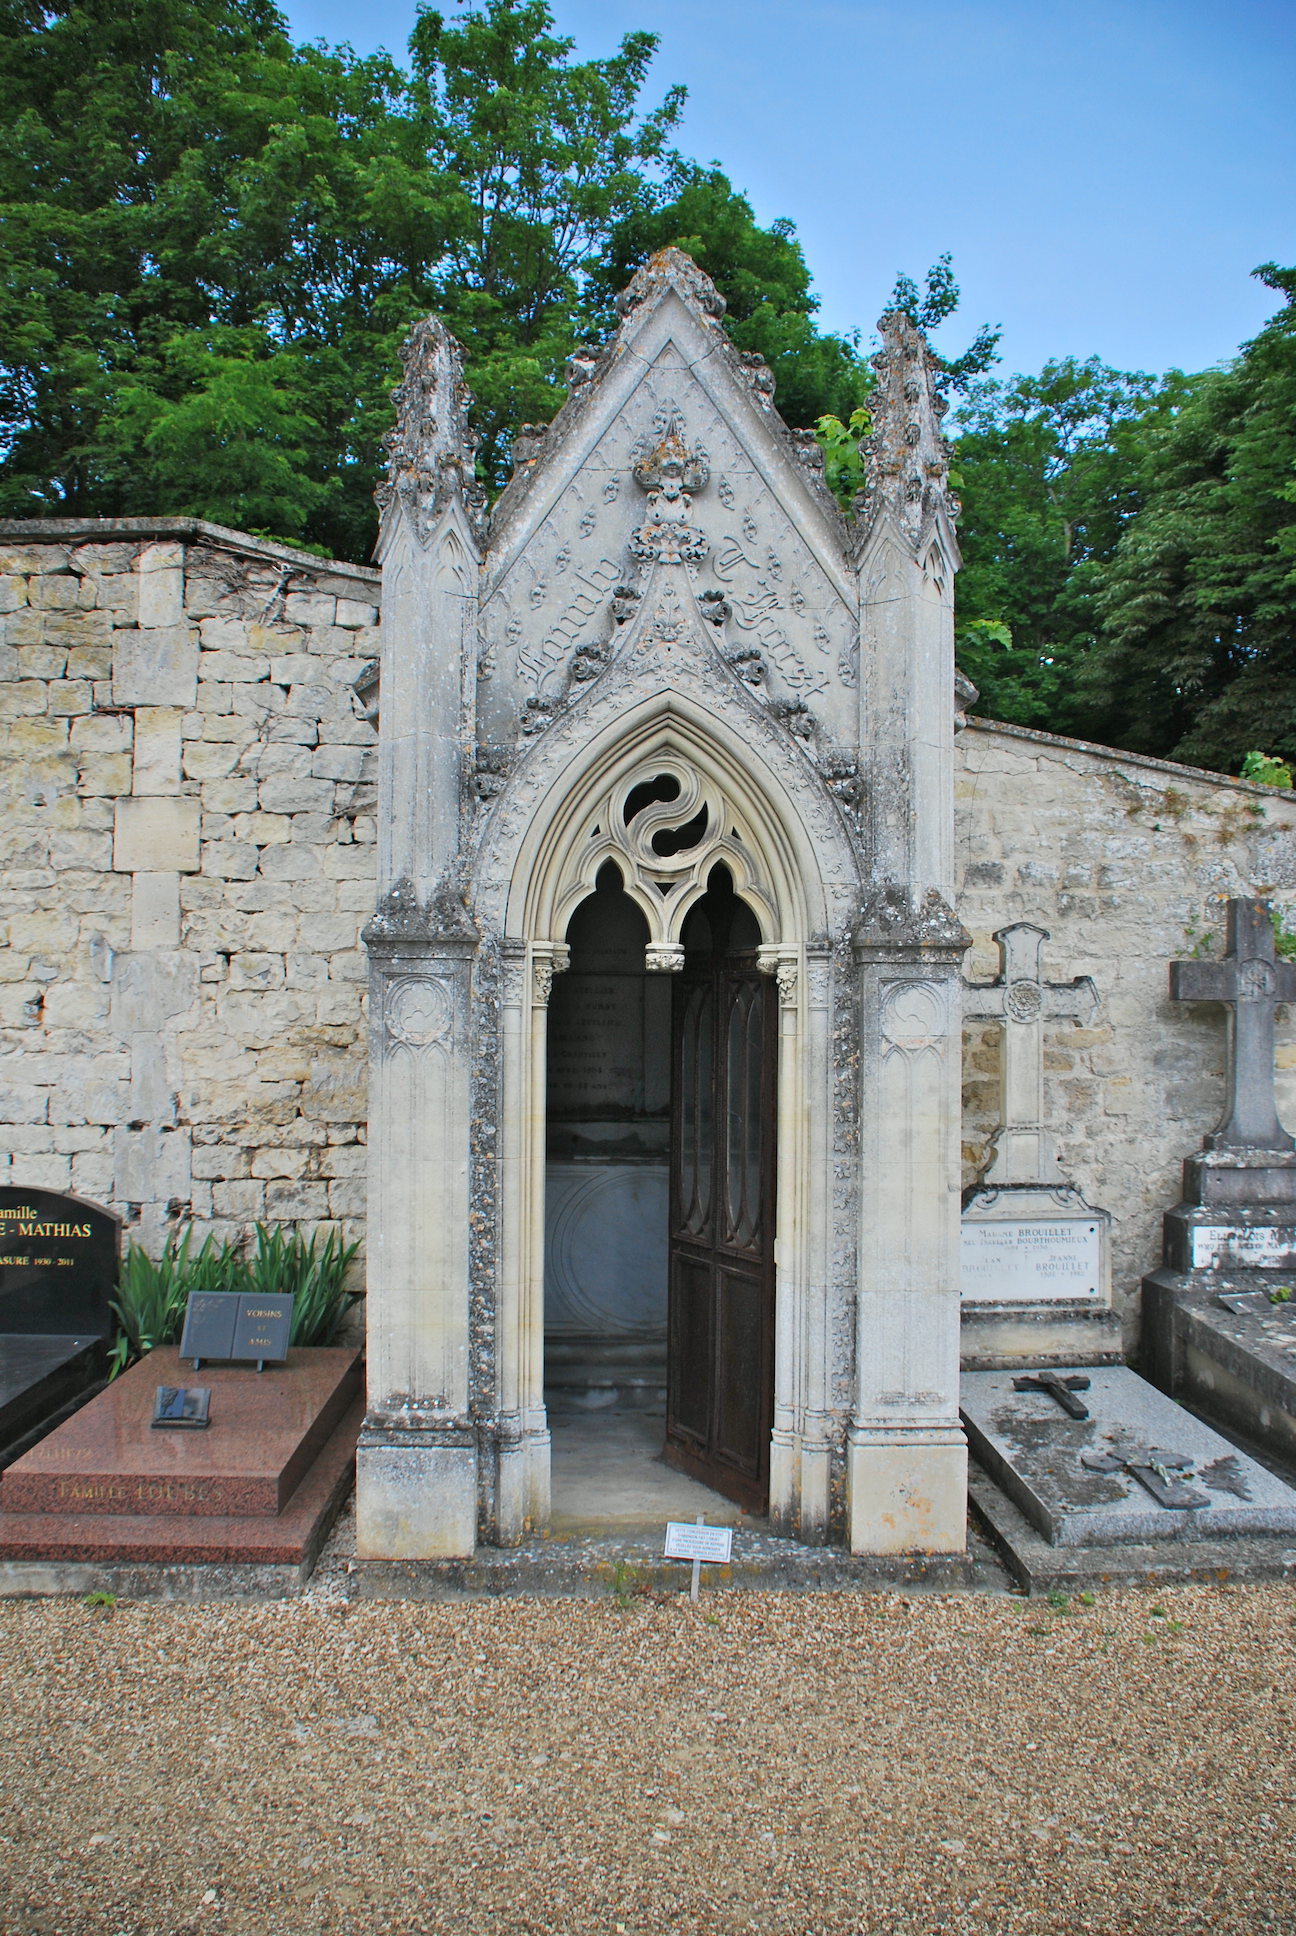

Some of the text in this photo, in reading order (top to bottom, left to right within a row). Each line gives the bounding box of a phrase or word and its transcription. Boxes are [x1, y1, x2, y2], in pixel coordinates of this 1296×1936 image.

[18, 1222, 92, 1238] MATHIAS
[1018, 1227, 1073, 1237] BROUILLET
[1035, 1262, 1090, 1272] BROUILLET
[245, 1309, 283, 1319] VOISINS
[58, 1481, 129, 1499] FAMILLE
